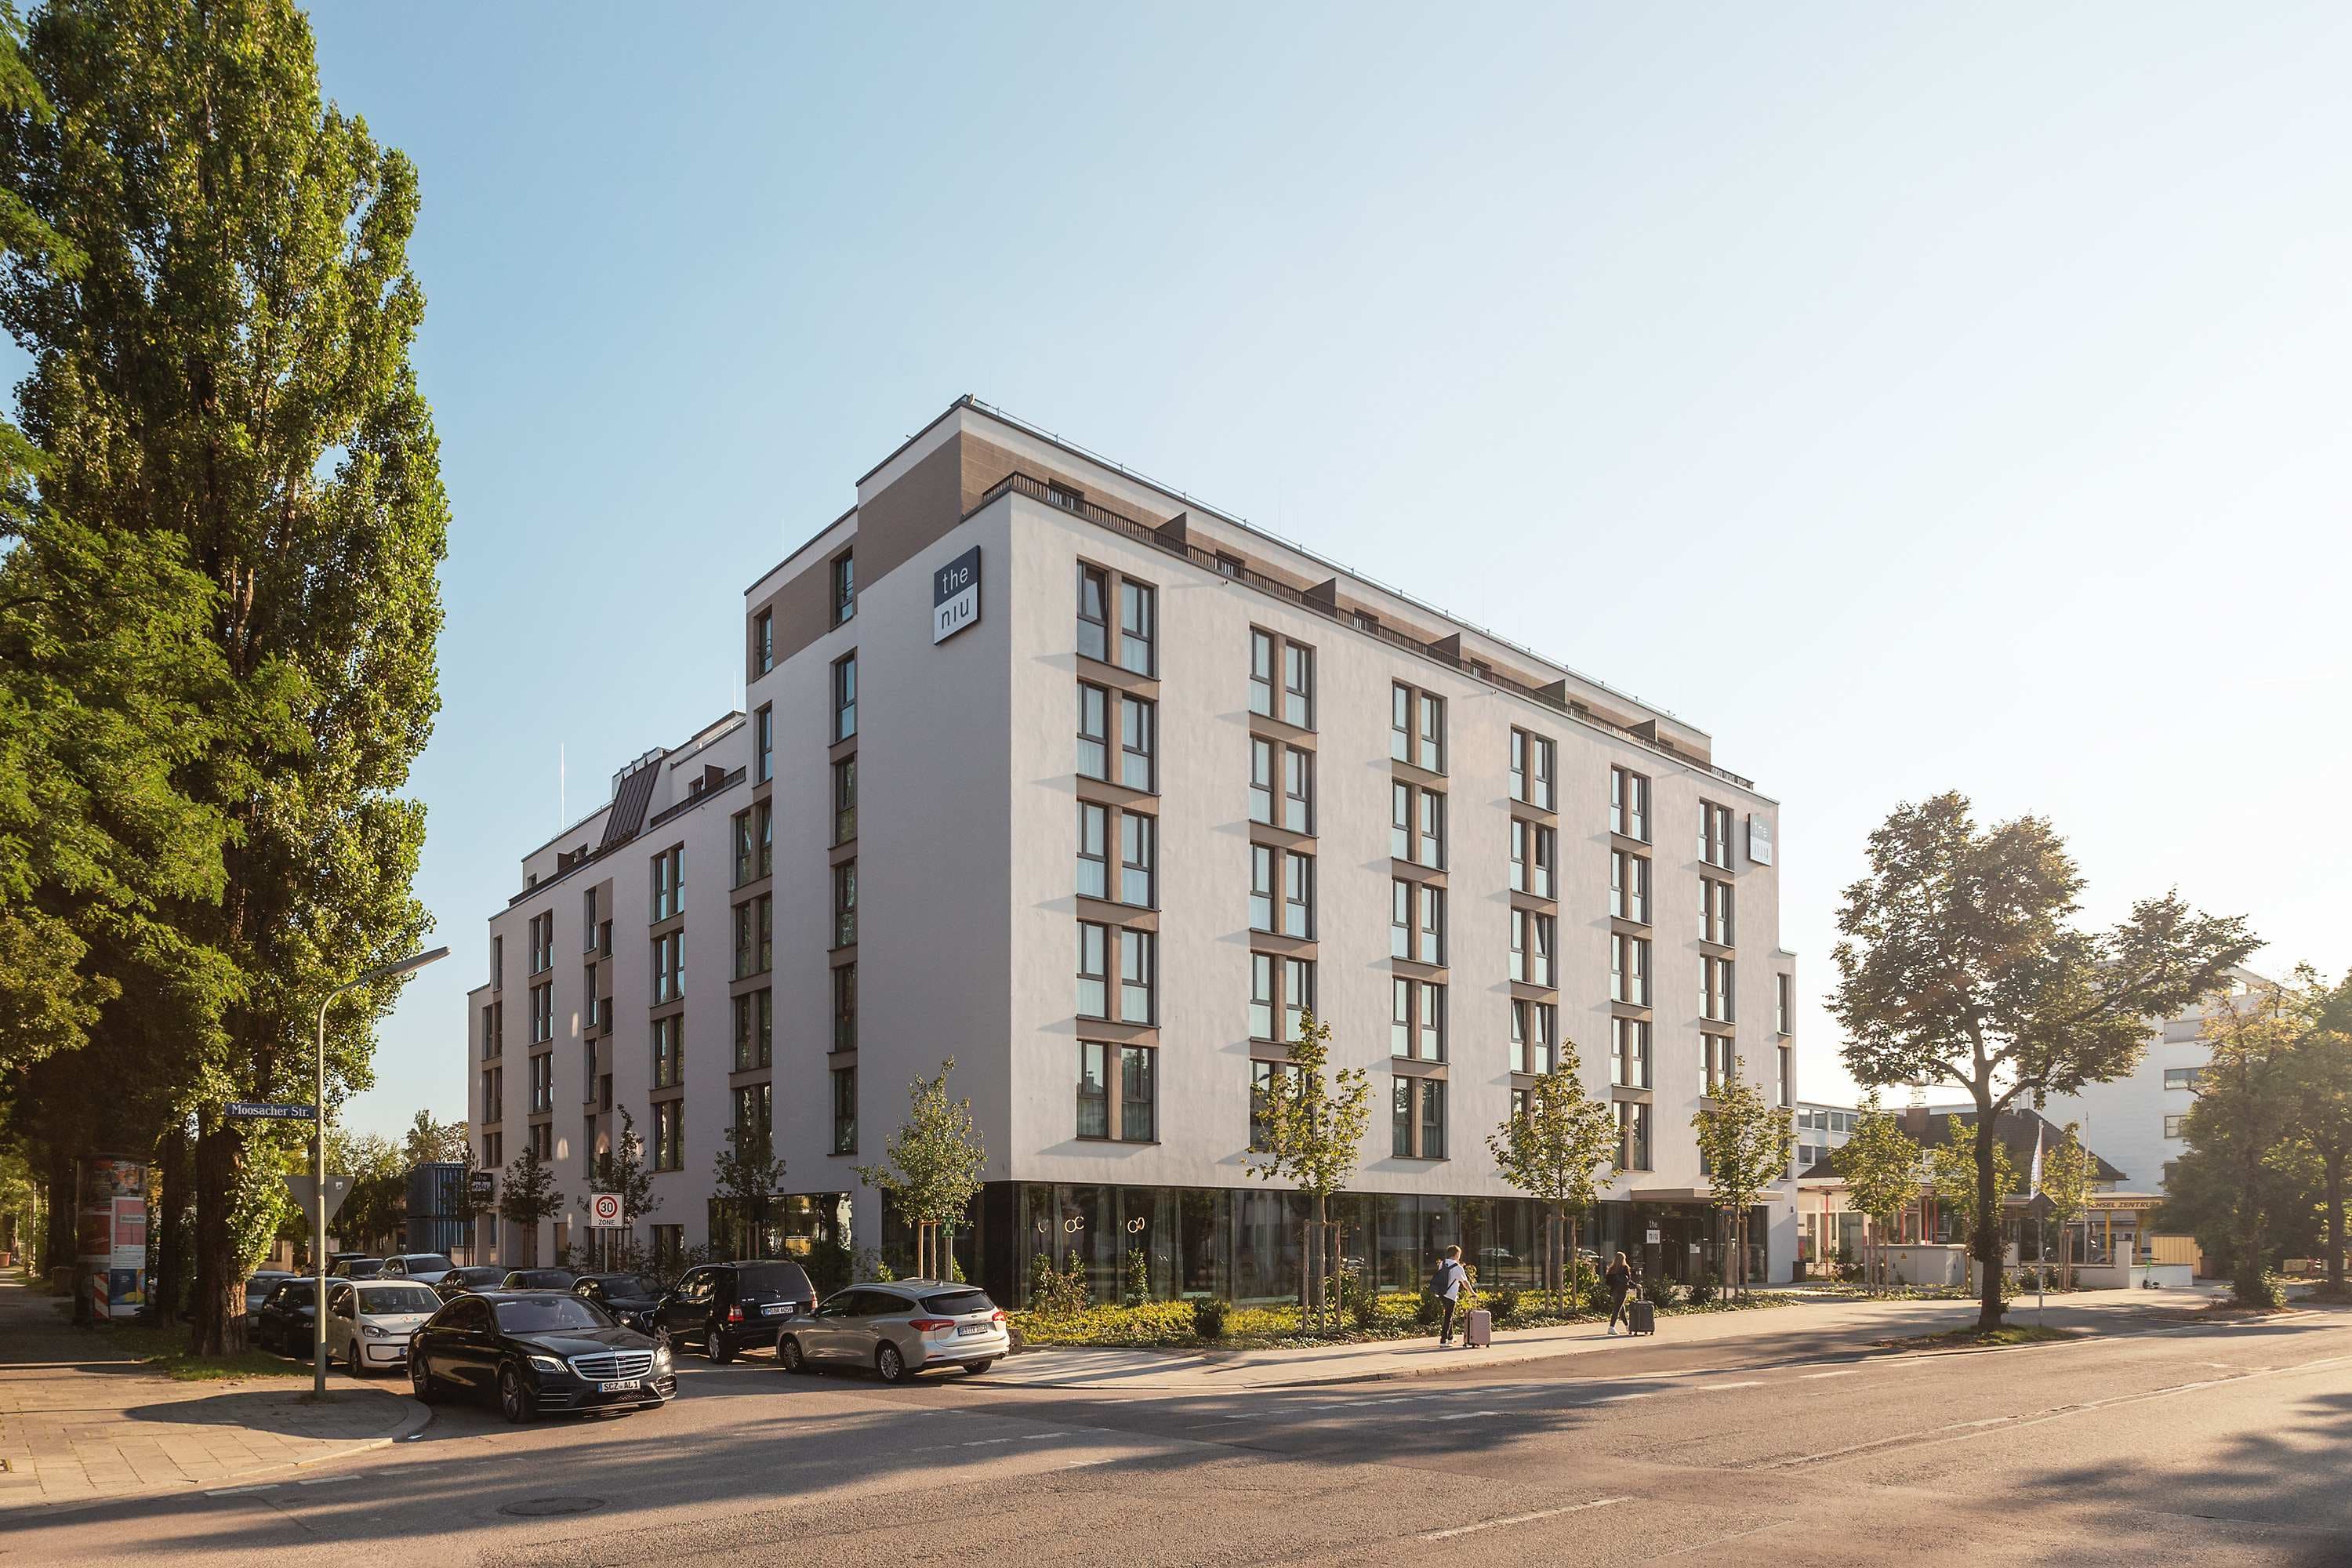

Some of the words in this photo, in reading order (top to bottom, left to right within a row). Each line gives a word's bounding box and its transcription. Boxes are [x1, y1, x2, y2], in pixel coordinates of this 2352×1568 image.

[942, 567, 968, 594] the
[941, 598, 969, 630] niu
[231, 1105, 289, 1116] Moosacher
[291, 1106, 310, 1117] Str.
[601, 1202, 613, 1213] 30
[604, 1382, 619, 1391] SCZ
